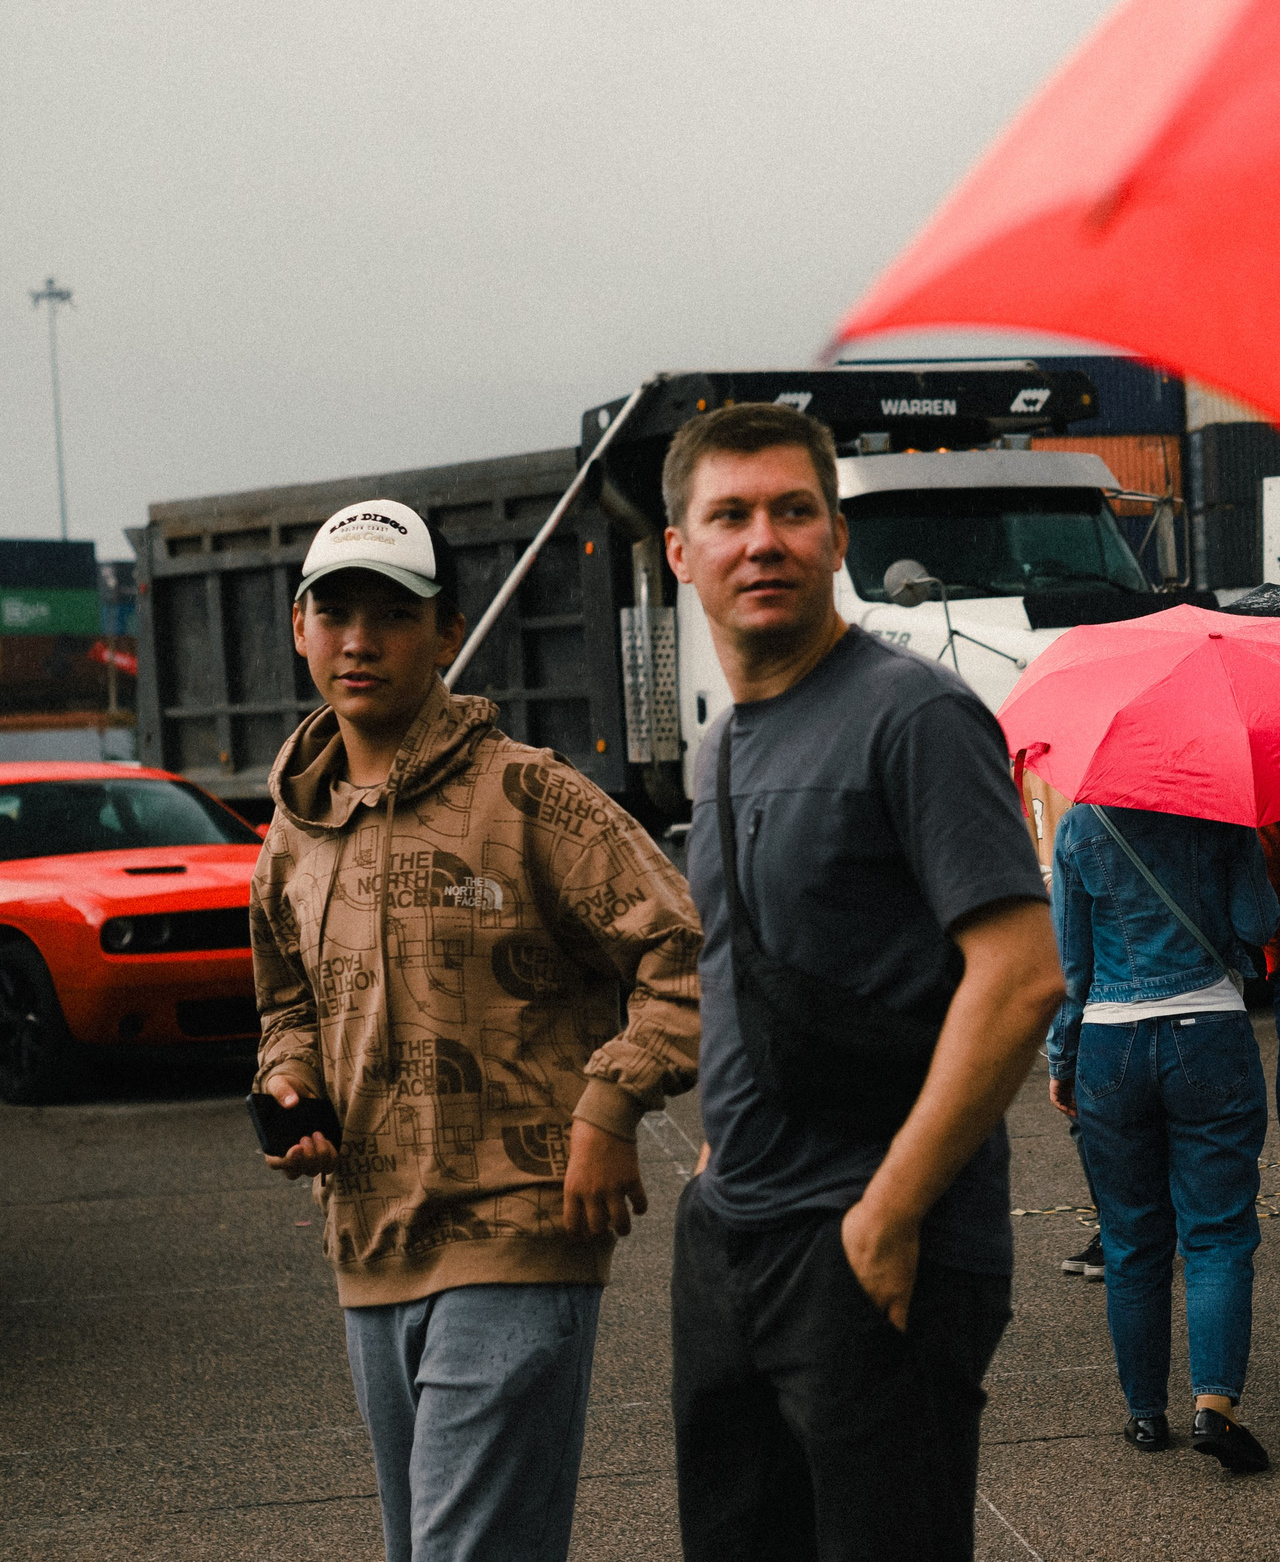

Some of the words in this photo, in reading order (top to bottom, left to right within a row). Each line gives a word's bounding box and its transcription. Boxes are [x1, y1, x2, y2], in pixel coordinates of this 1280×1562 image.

[881, 399, 957, 415] WARREN
[329, 514, 358, 534] SAN
[361, 513, 408, 535] DIEGO
[541, 803, 585, 838] THE
[388, 851, 432, 870] THE
[357, 870, 430, 896] NORTH
[444, 886, 483, 897] NORTH
[463, 876, 485, 887] THE
[454, 897, 482, 907] FACE
[322, 952, 363, 979] FACE
[393, 1039, 435, 1060] THE
[362, 1058, 434, 1083] NRTH
